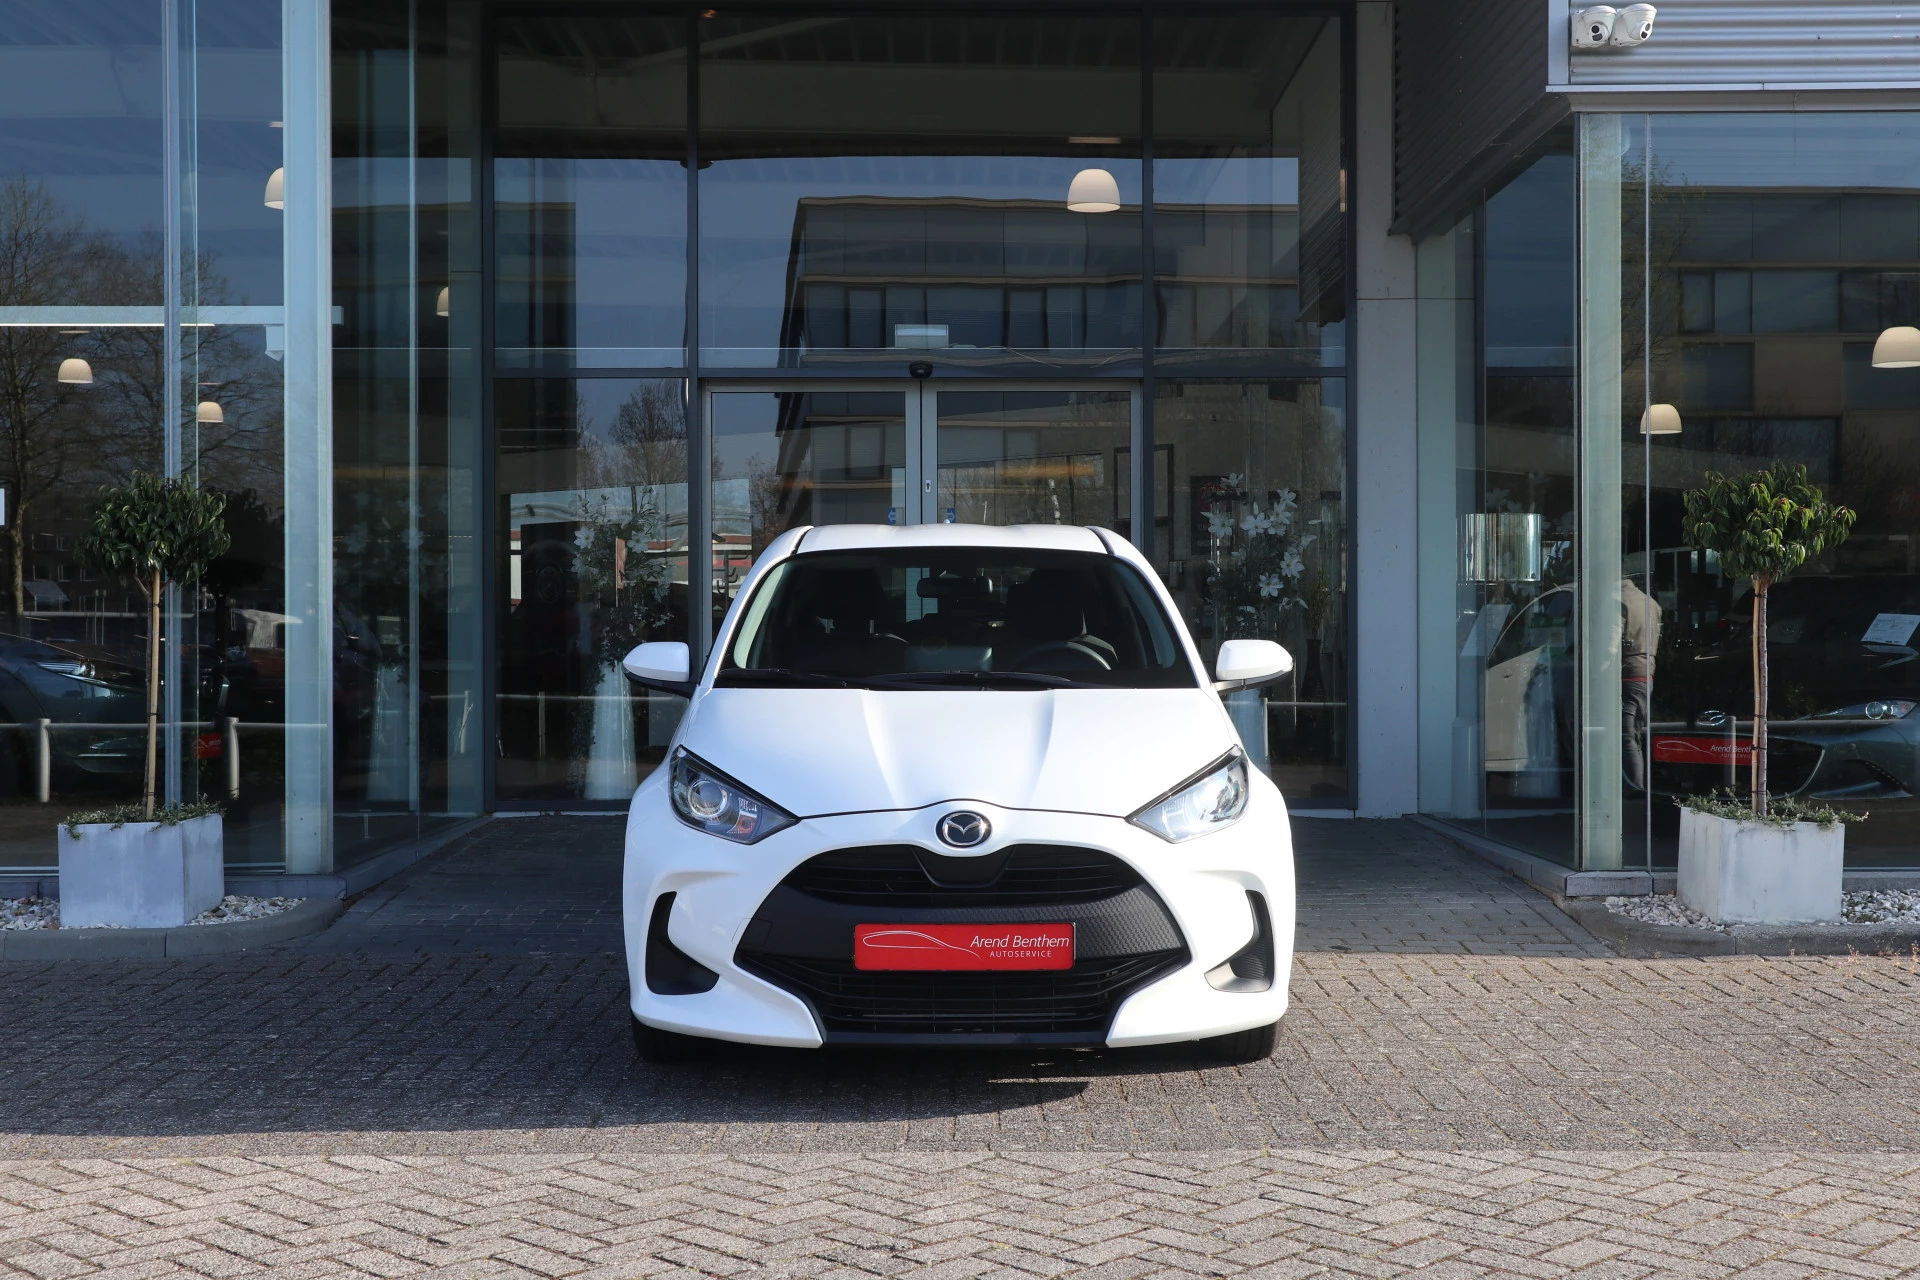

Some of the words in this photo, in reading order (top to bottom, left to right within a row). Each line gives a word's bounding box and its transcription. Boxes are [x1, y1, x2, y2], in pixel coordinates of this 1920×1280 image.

[1710, 744, 1731, 753] Arend
[970, 934, 1009, 948] Arend
[1012, 934, 1069, 948] Benthem
[989, 950, 1052, 958] AUTOSERVICE
